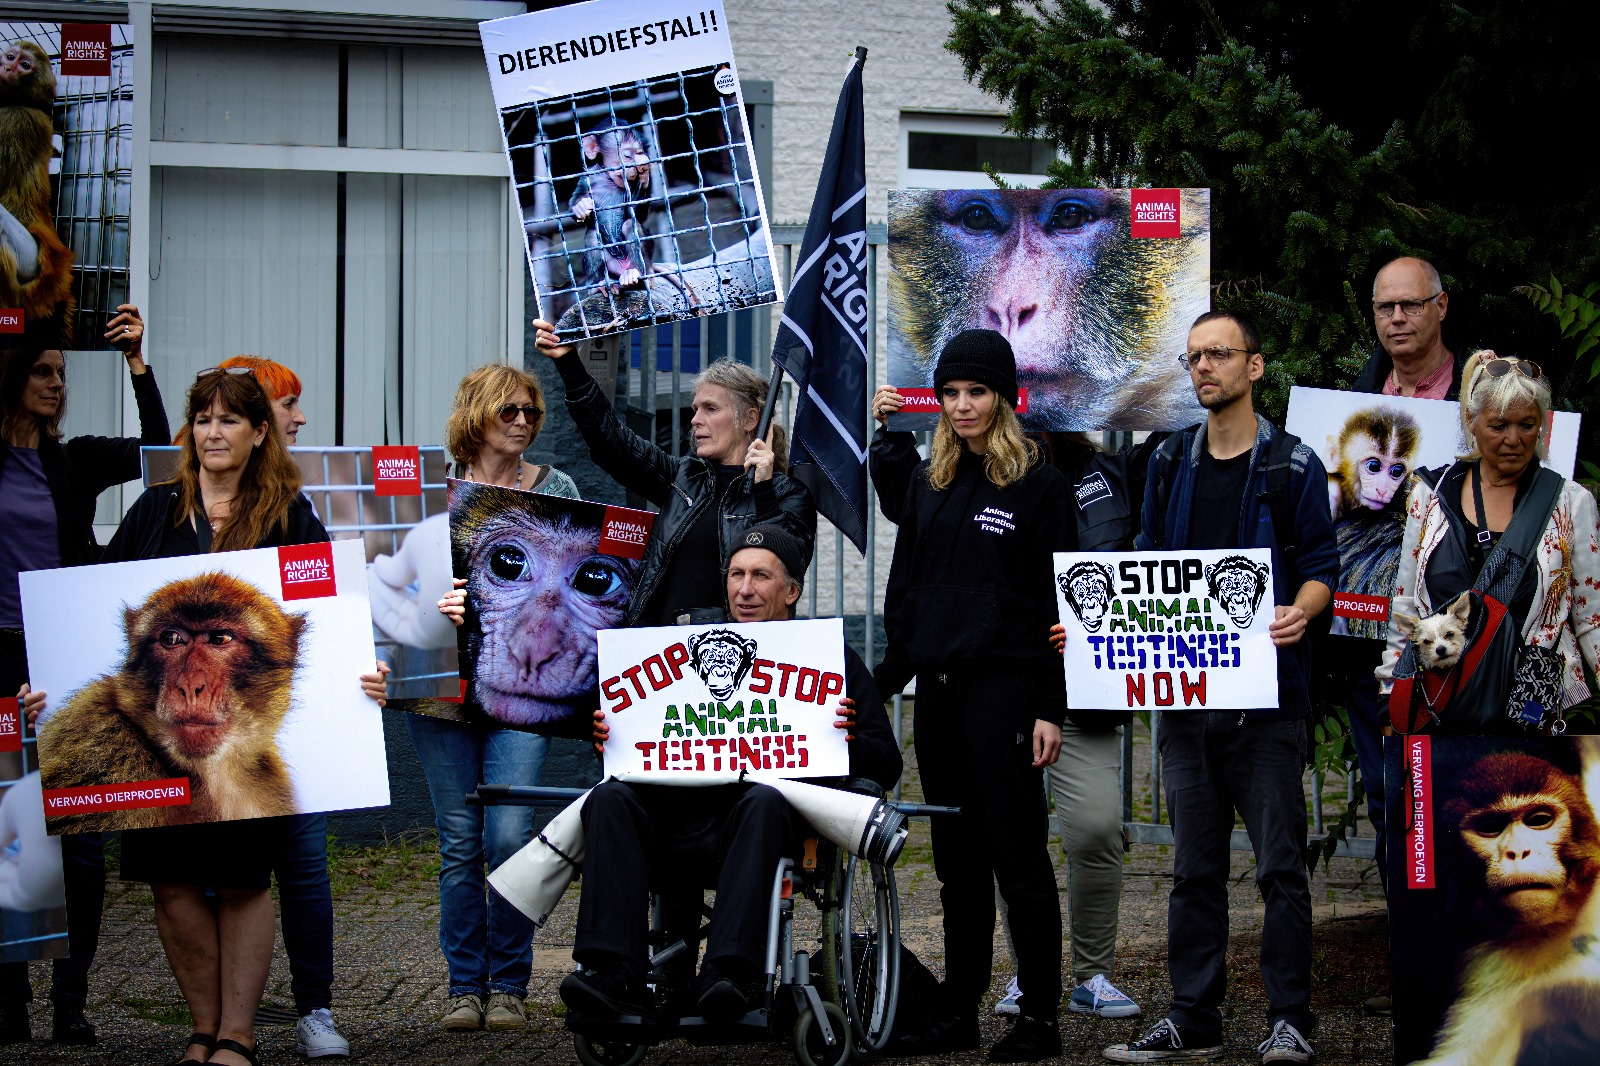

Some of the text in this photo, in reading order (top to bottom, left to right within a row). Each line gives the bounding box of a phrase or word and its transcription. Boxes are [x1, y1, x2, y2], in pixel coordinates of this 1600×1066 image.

[65, 40, 108, 50] ANIMAL
[499, 10, 719, 75] DIERENDIEFSTAL!!
[67, 49, 105, 59] RIGHTS
[1134, 202, 1177, 212] ANIMAL
[1137, 211, 1176, 221] RIGHTS
[377, 458, 417, 469] ANIMAL
[379, 467, 415, 478] RIGHTS
[982, 506, 1014, 520] Animal
[606, 520, 648, 535] ANIMAL
[973, 514, 1016, 531] Liberation
[980, 523, 1004, 536] Front
[607, 528, 645, 543] RIGHTS
[284, 558, 330, 572] ANIMAL
[287, 567, 328, 581] RIGHTS
[1118, 558, 1203, 595] STOP
[1109, 597, 1226, 633] ANIMAL
[601, 642, 844, 714] STOP STOP
[1125, 671, 1207, 707] NOW
[662, 699, 792, 738] ANIMAL
[635, 734, 810, 772] TESTINGS
[49, 786, 185, 808] VERVANG DIERPROEVEN
[1412, 741, 1426, 883] VERVANG DIERPROEVEN
